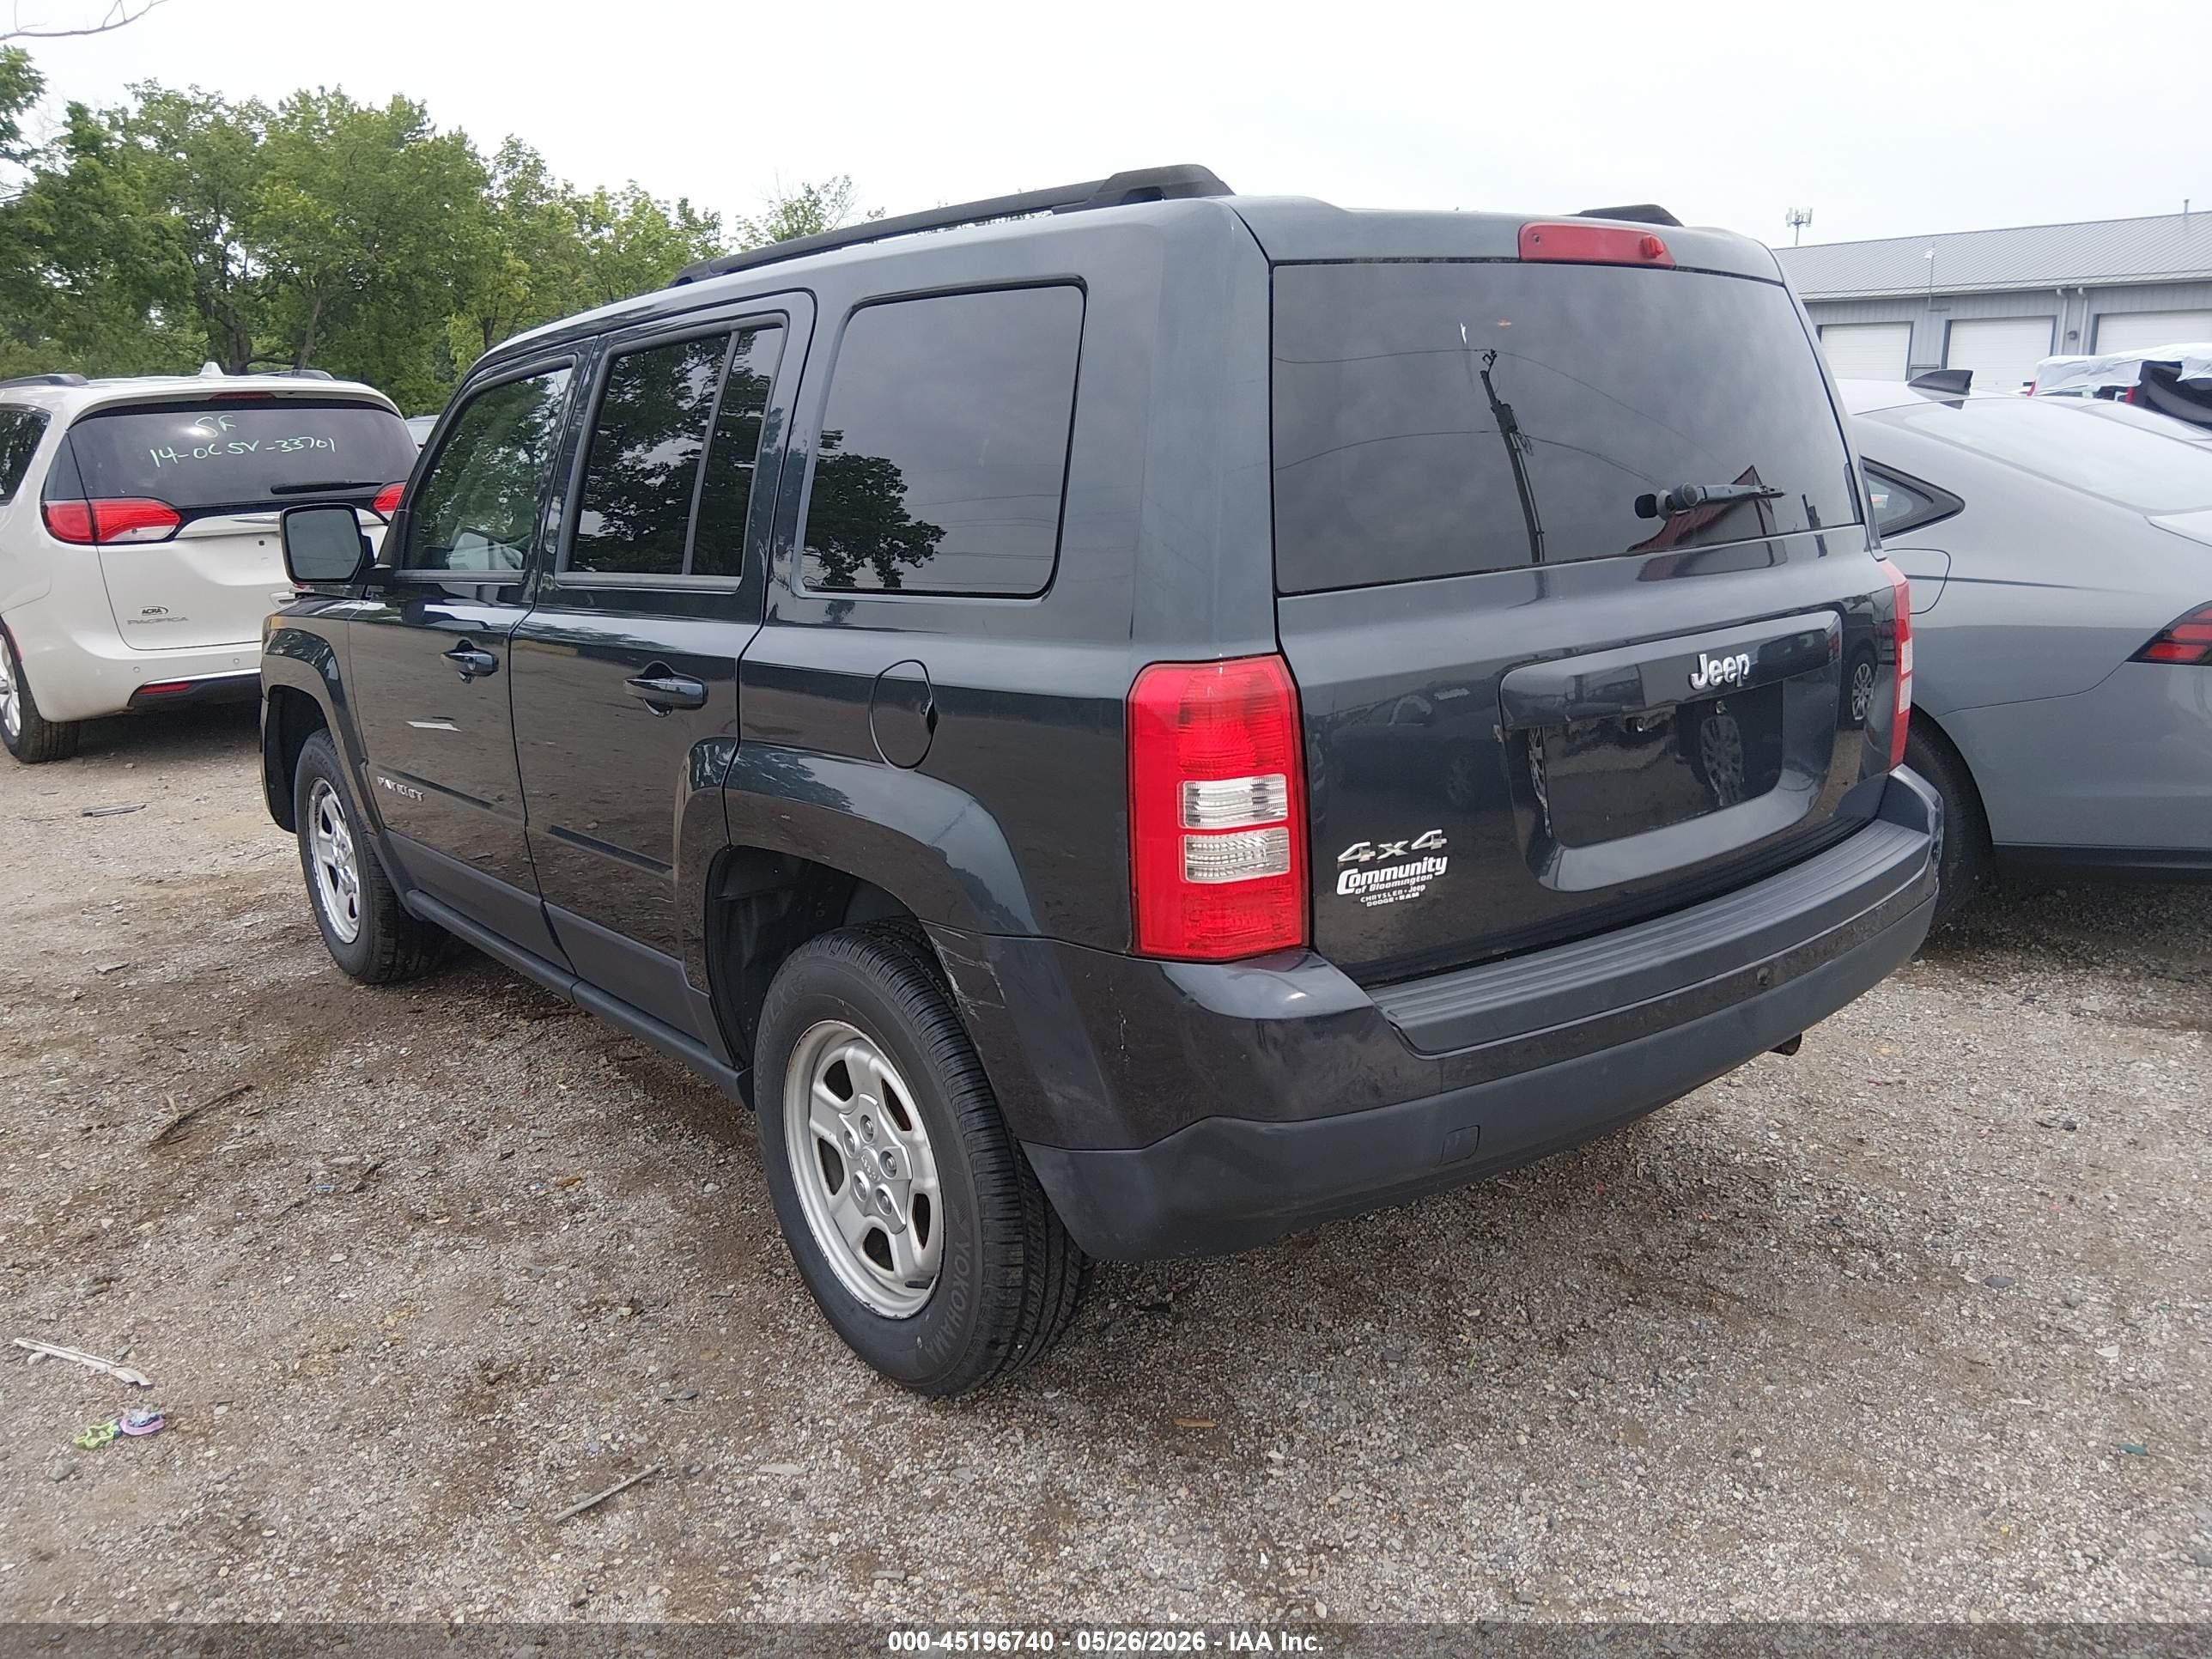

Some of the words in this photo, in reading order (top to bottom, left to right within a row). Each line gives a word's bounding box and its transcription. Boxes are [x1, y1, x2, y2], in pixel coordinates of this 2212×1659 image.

[1690, 653, 1750, 690] Jeep
[1337, 856, 1449, 895] Community
[1354, 885, 1367, 895] of
[1369, 873, 1433, 892] Bloomington
[1408, 884, 1425, 894] Jeep
[925, 1241, 970, 1364] YOKOHAMA
